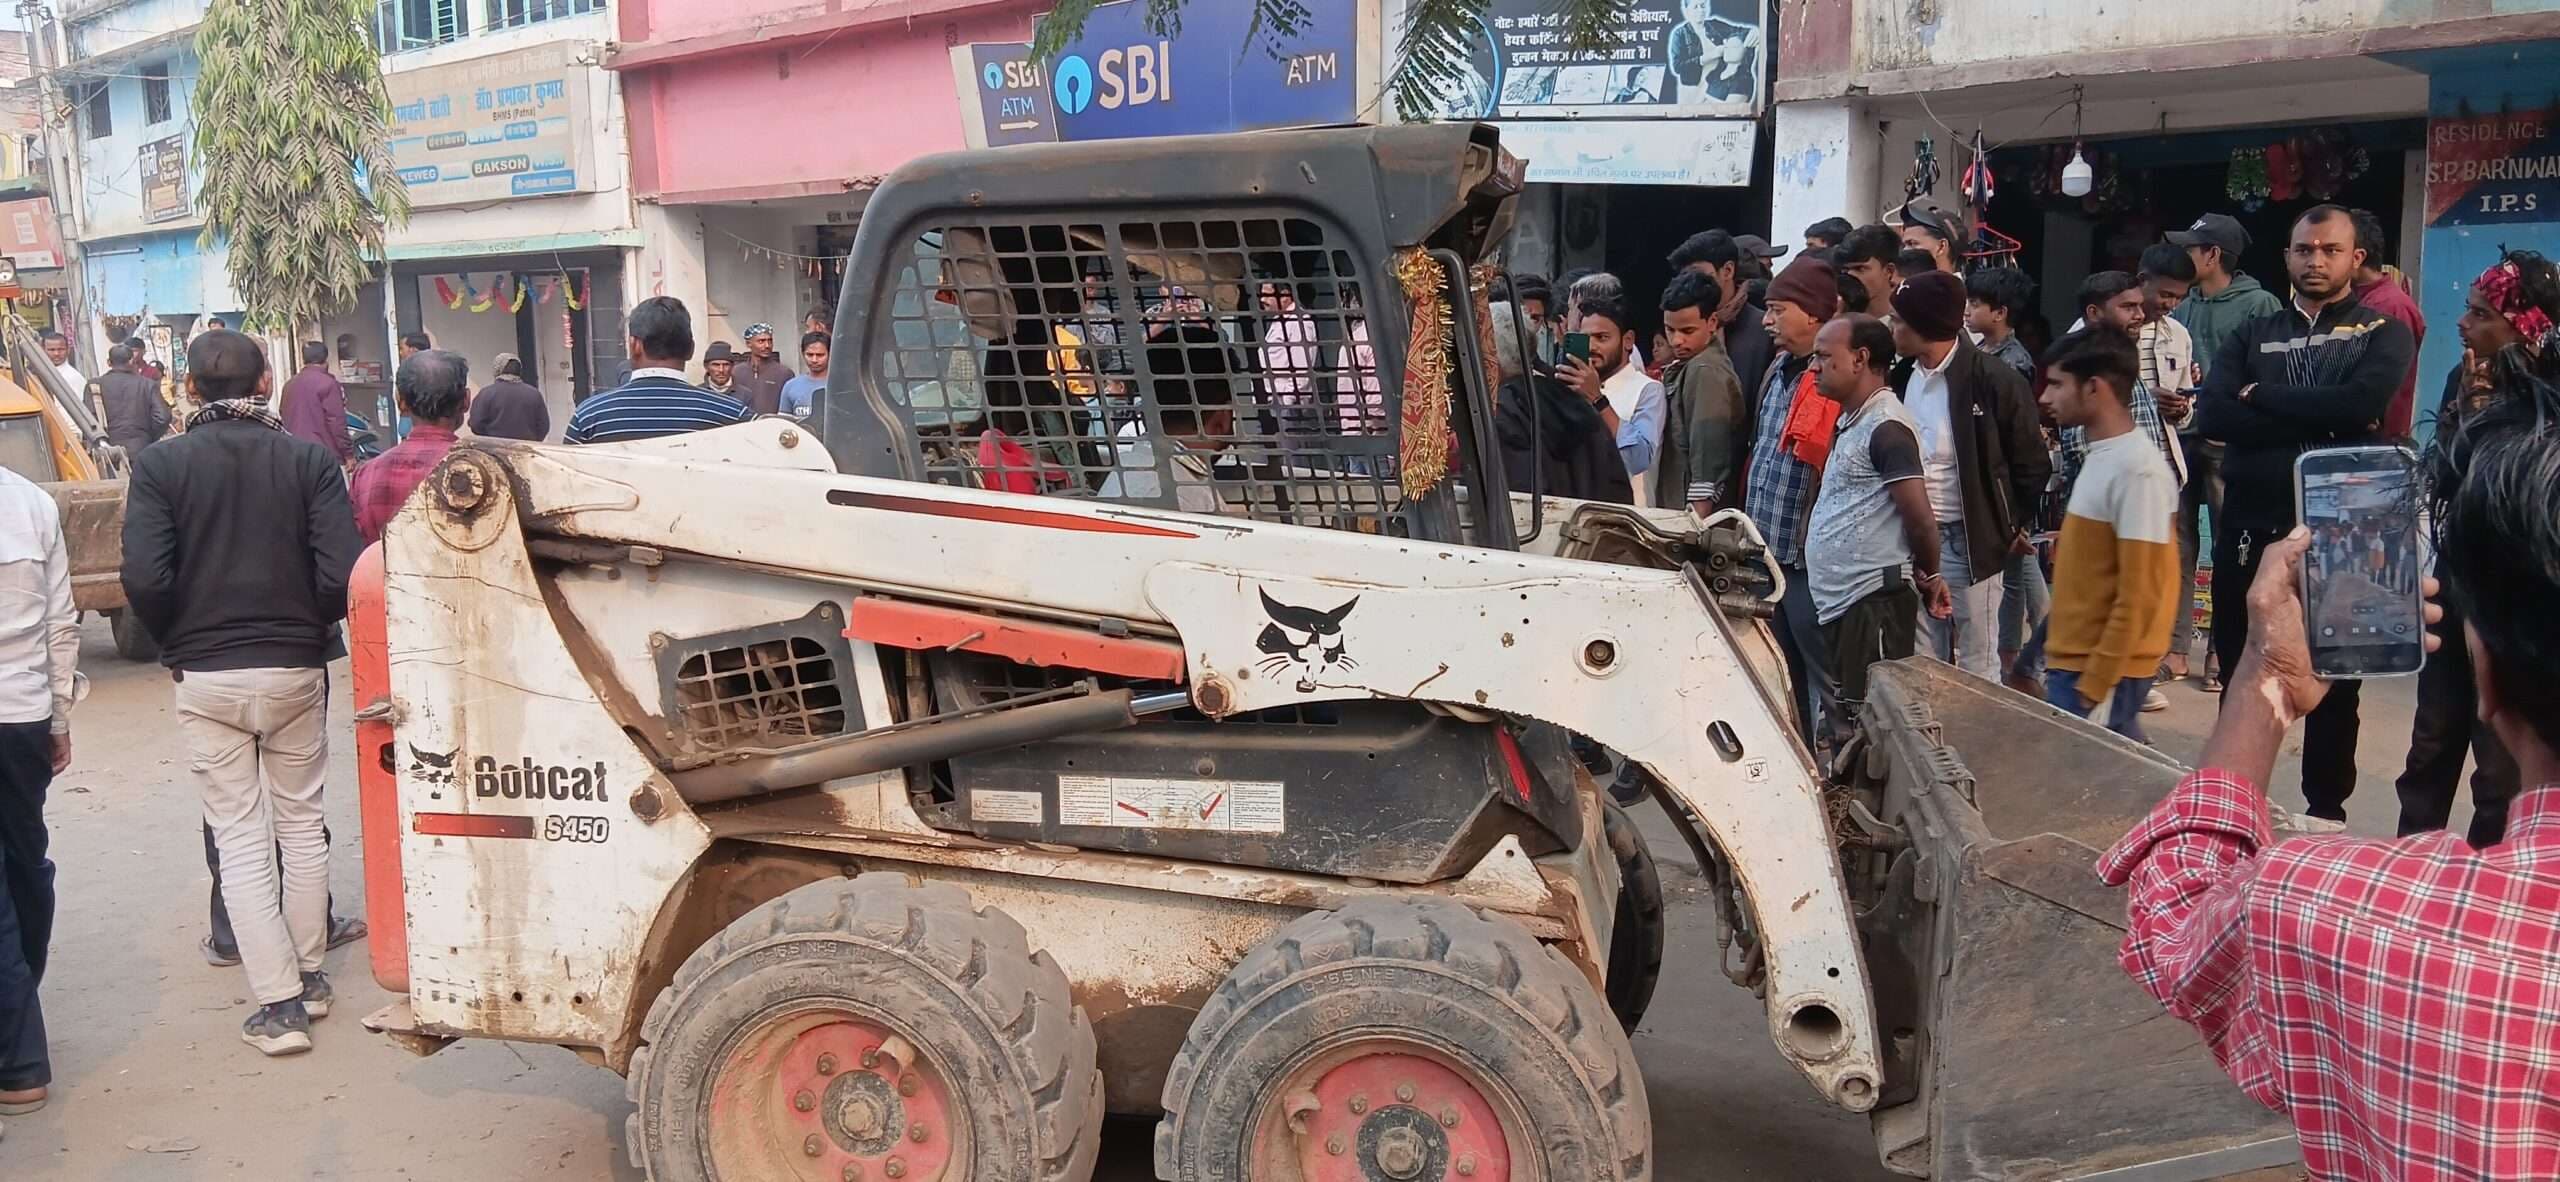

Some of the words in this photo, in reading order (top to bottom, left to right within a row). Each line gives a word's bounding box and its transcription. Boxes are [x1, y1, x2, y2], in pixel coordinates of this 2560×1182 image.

[1005, 61, 1041, 89] SBI
[1099, 41, 1170, 109] SBI
[1287, 52, 1336, 85] ATM
[1001, 96, 1035, 117] ATM
[2435, 121, 2545, 144] RESIDENCE
[474, 157, 528, 175] BAKSON
[474, 755, 608, 802] Bobcat
[545, 815, 610, 843] S450
